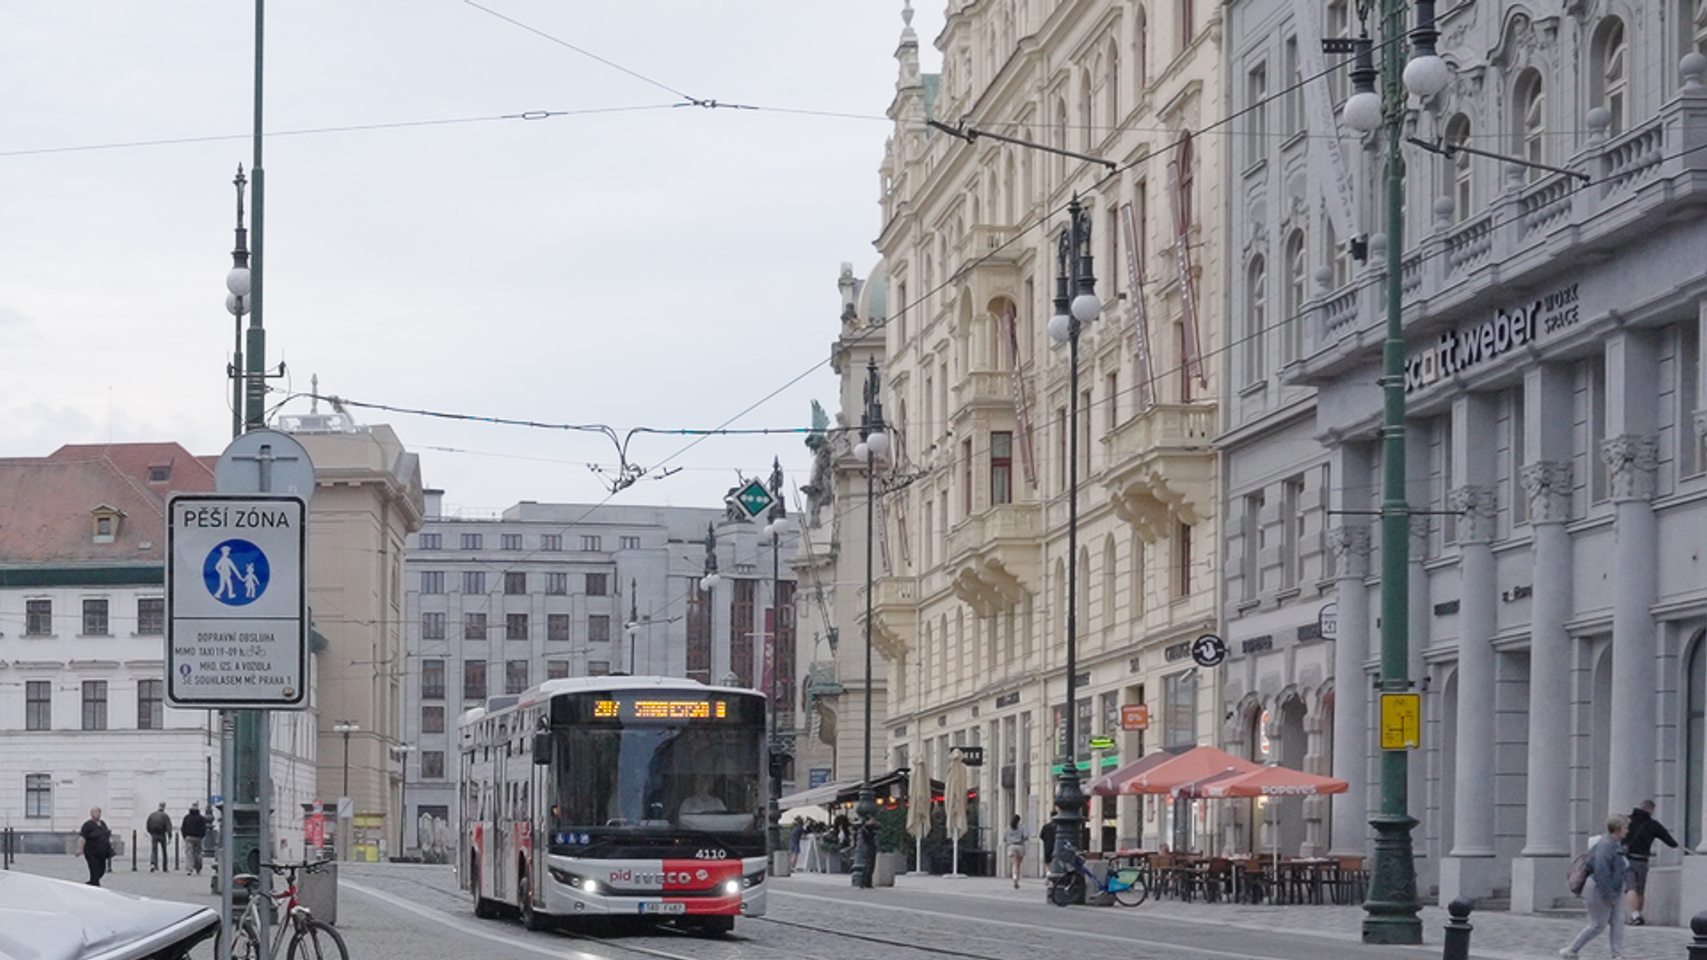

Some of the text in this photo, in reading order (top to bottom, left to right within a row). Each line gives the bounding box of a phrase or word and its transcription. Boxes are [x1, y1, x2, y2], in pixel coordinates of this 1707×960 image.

[1545, 284, 1579, 313] WORK
[1545, 305, 1579, 334] SPACE
[184, 506, 290, 528] PĚŠÍ ZÓNA
[174, 647, 196, 657] MIMO
[1261, 784, 1317, 795] POPEYES
[695, 849, 727, 859] 4110
[609, 869, 632, 882] pid
[634, 872, 691, 885] IVECO
